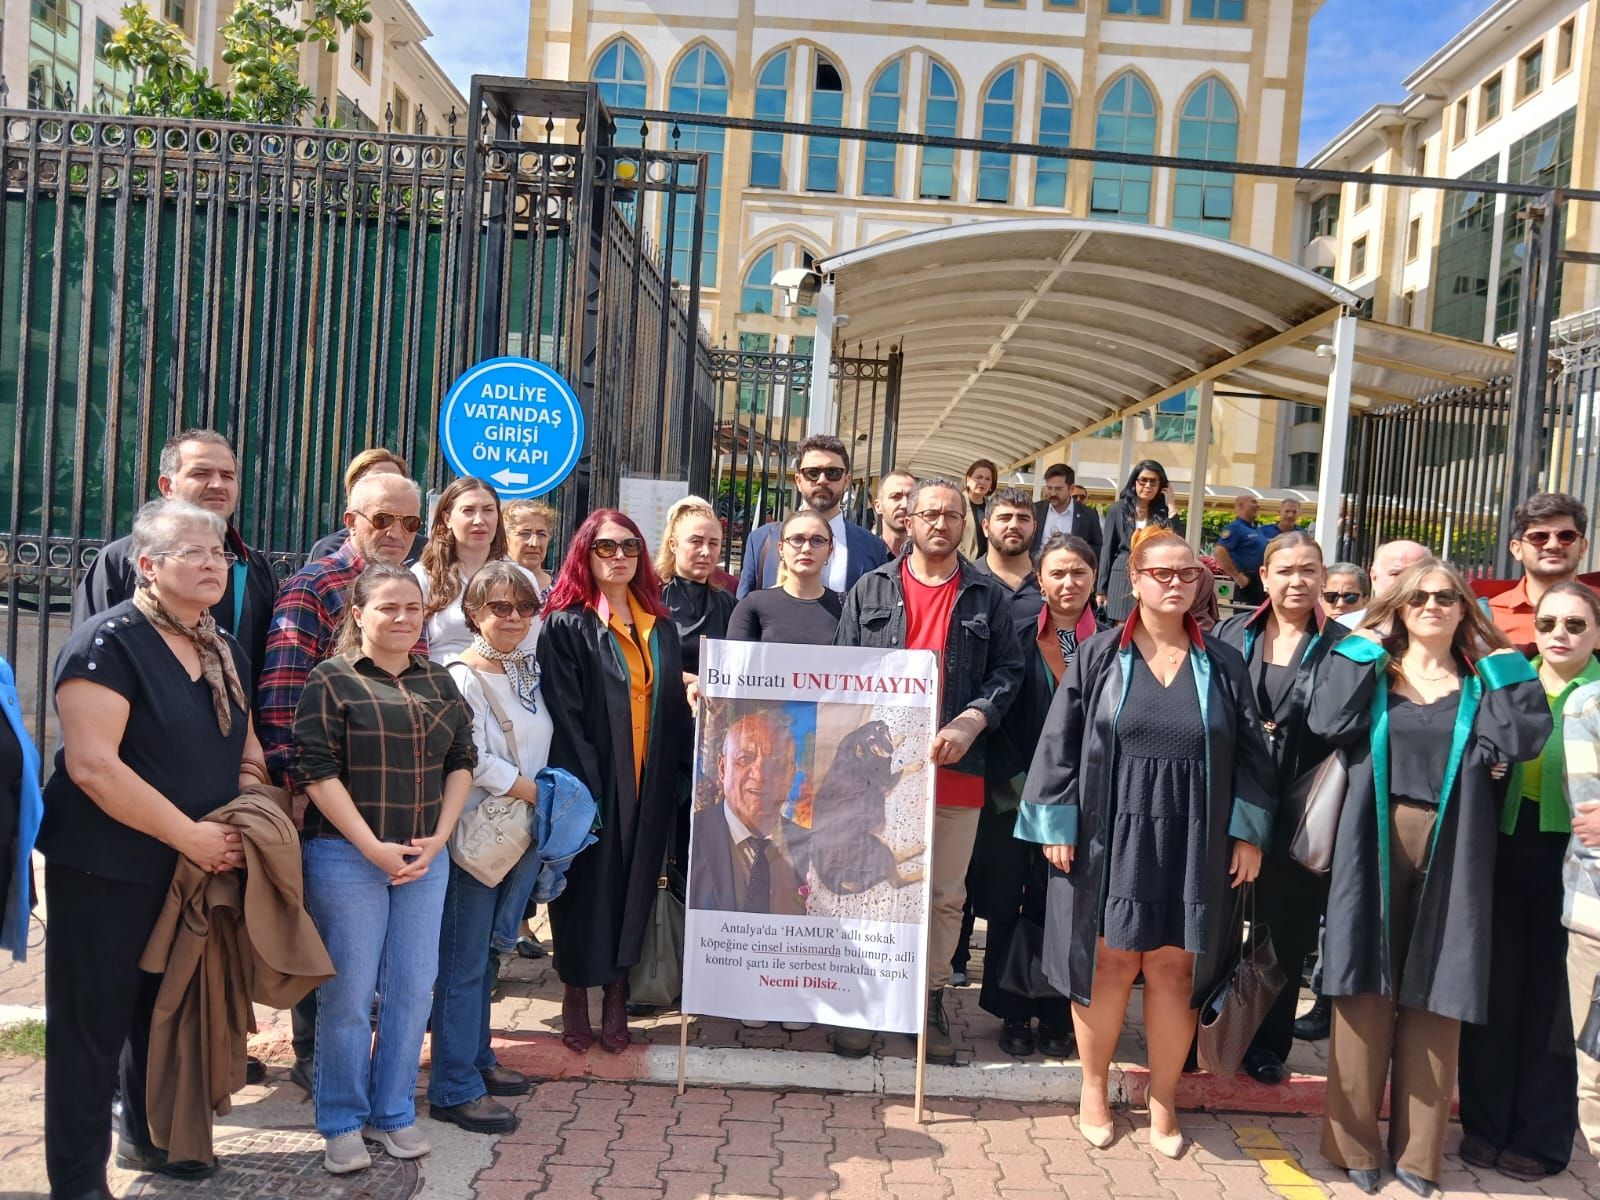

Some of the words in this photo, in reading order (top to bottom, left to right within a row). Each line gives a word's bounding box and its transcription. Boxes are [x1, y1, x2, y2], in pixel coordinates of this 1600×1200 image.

[481, 383, 547, 403] ADLİYE
[464, 403, 562, 429] VATANDAŞ
[484, 424, 539, 446] GİRİŞİ
[472, 443, 500, 462] ÖN
[505, 448, 548, 465] KAPI
[707, 668, 731, 686] Bu
[737, 671, 785, 688] suratı
[792, 672, 933, 695] UNUTMAYIN!
[720, 922, 777, 937] Antalya'da
[841, 929, 861, 941] adlı
[864, 932, 896, 944] sokak
[700, 937, 748, 952] köpeğine
[751, 941, 783, 953] cinsel
[786, 942, 841, 956] istismarda
[844, 945, 892, 963] bulunup,
[894, 951, 915, 963] adli
[705, 953, 742, 967] kontrol
[745, 958, 769, 970] şartı
[772, 958, 786, 969] ile
[788, 959, 826, 971] serbest
[829, 961, 876, 976] bırakılan
[879, 968, 909, 981] sapık
[759, 974, 799, 987] Necmi
